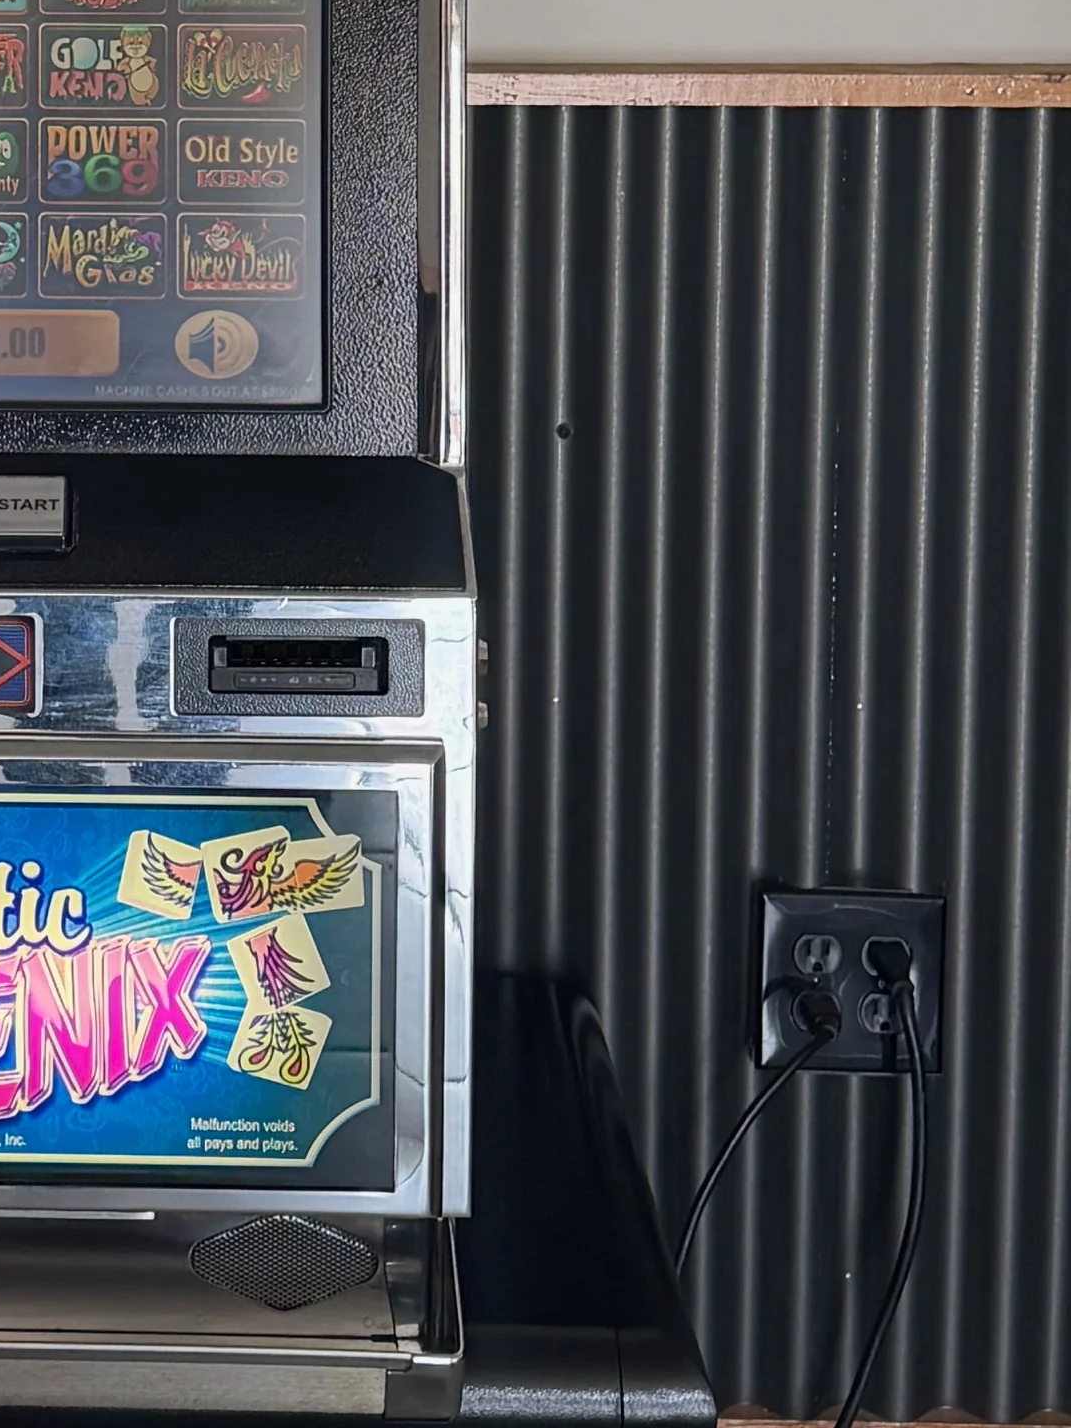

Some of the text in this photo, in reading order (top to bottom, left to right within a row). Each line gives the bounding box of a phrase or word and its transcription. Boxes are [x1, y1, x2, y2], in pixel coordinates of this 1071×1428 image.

[51, 37, 123, 70] GOLF
[49, 72, 127, 101] KENO
[47, 125, 159, 162] POWER
[185, 135, 298, 168] Old Style
[197, 169, 289, 188] KENO
[190, 1117, 296, 1133] Malfunction voids
[5, 1133, 26, 1147] Inc.
[187, 1136, 299, 1154] all pays and plays.
